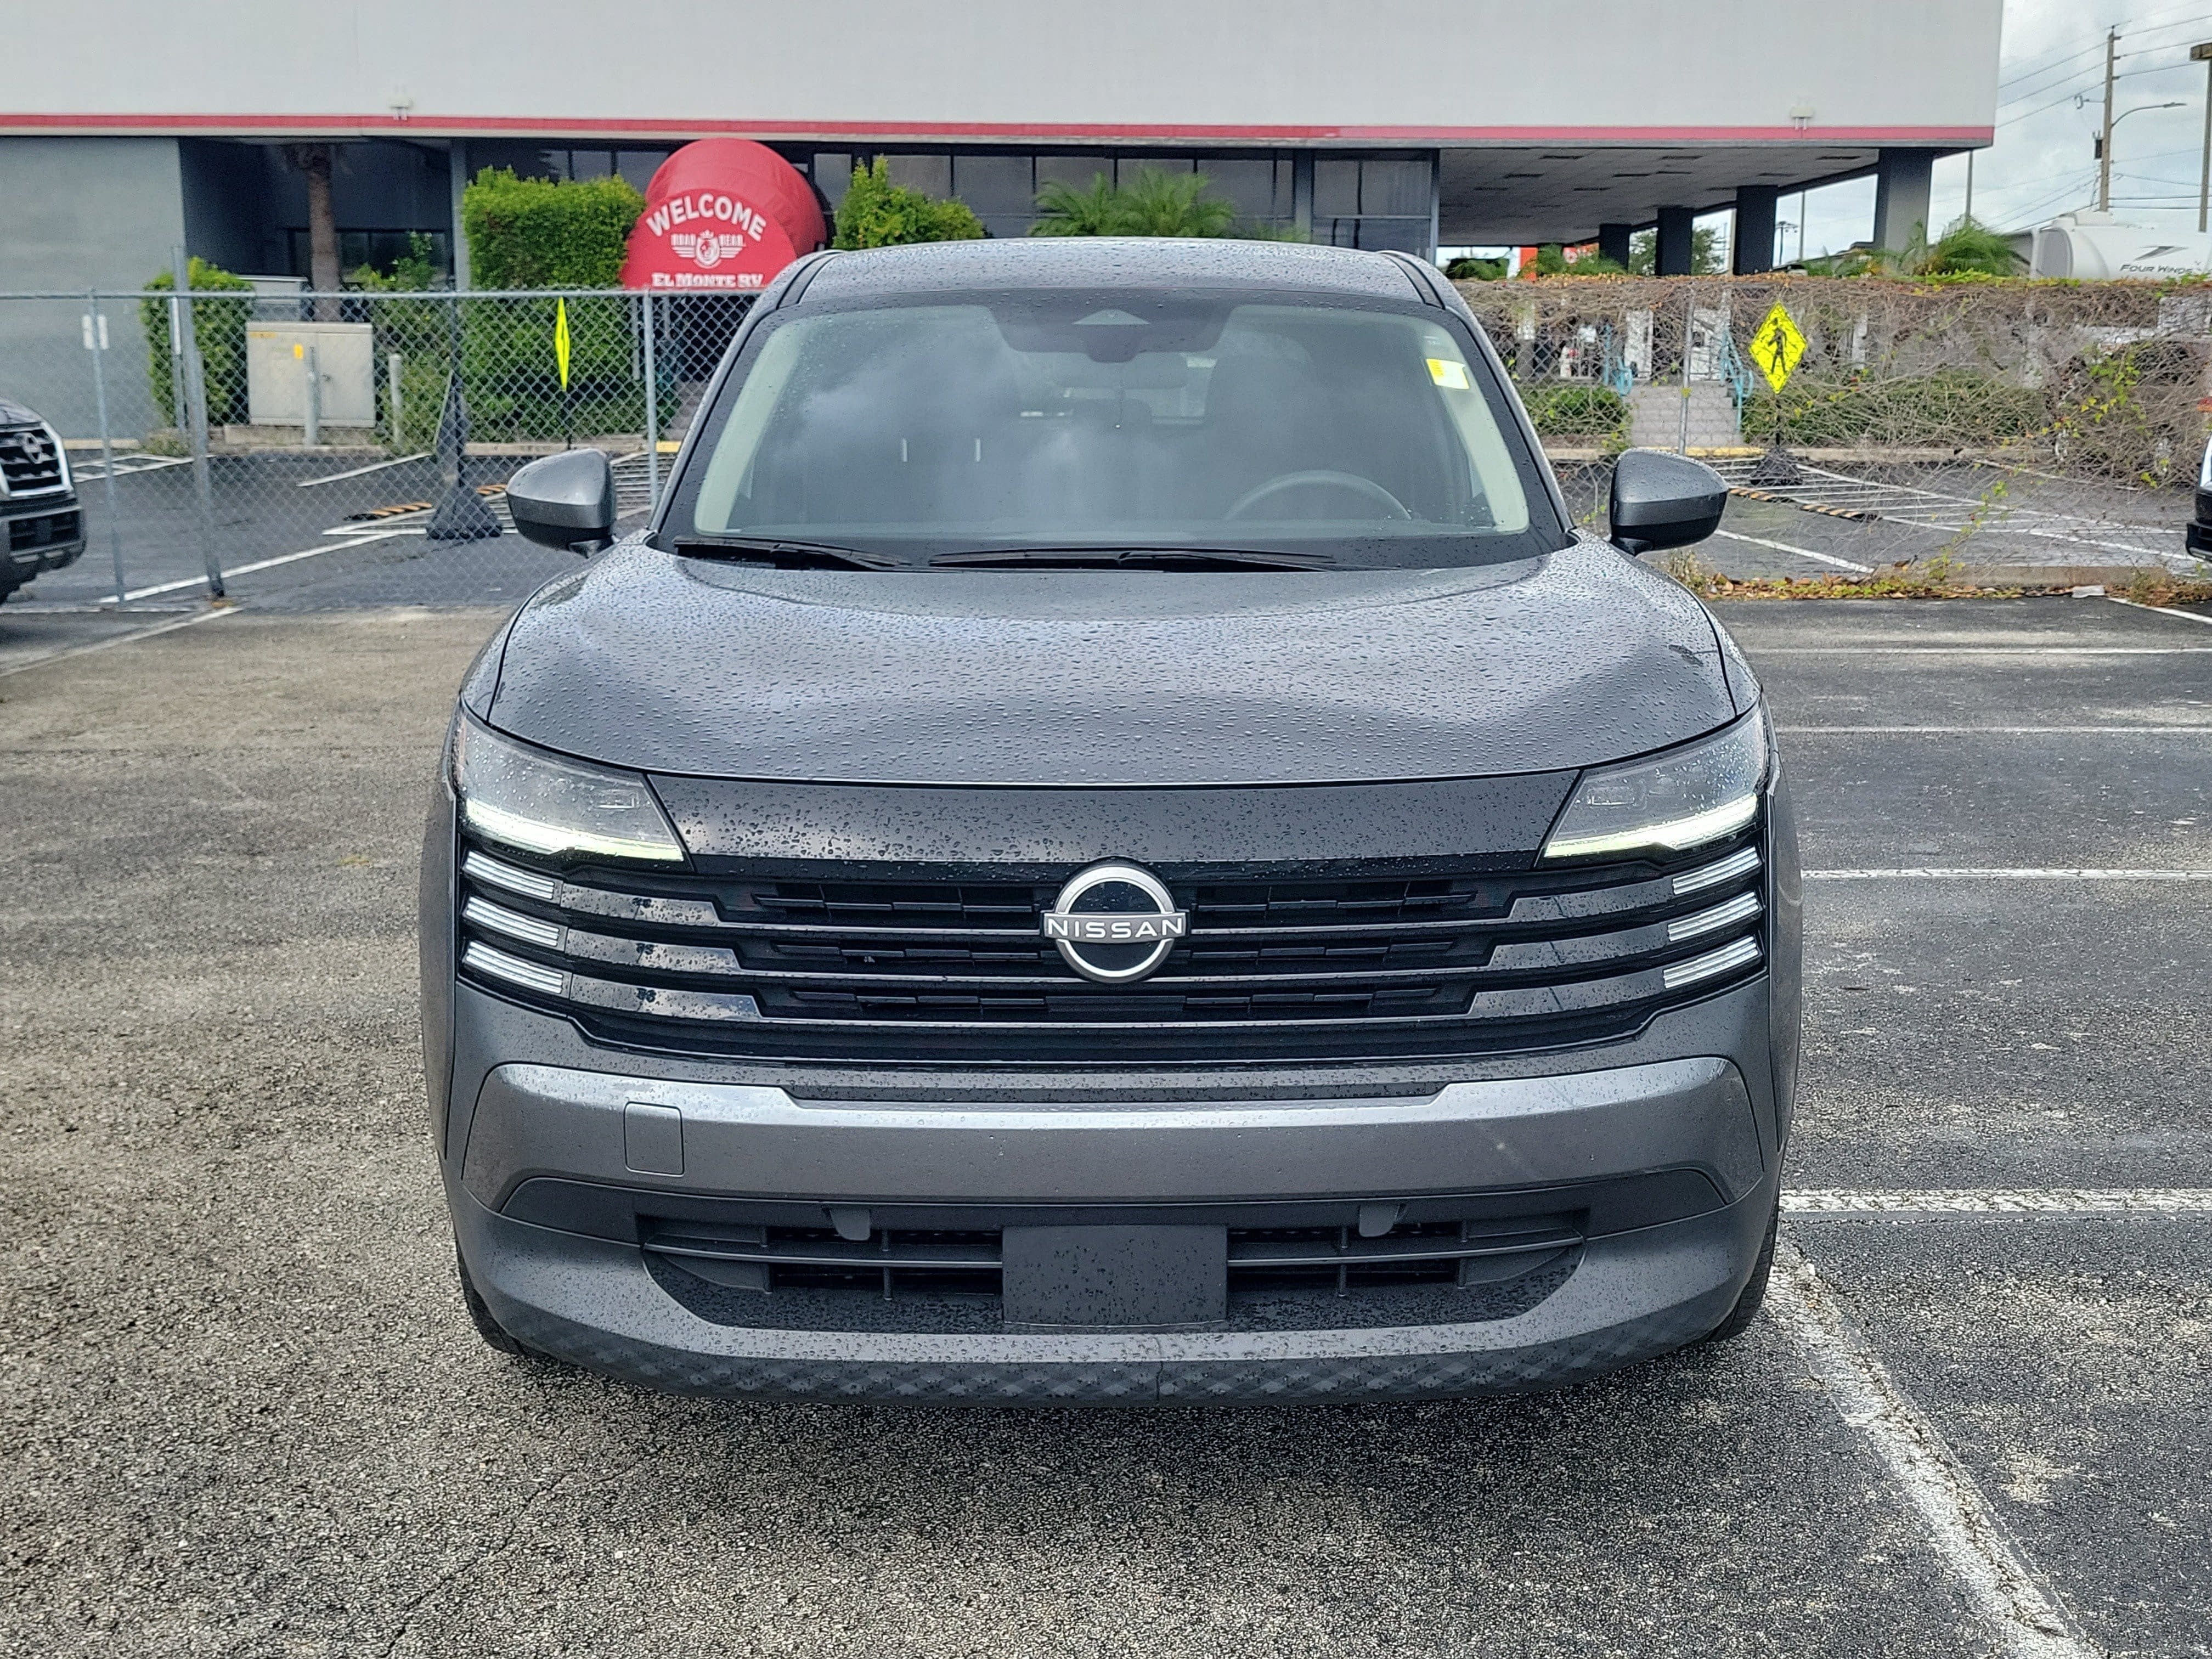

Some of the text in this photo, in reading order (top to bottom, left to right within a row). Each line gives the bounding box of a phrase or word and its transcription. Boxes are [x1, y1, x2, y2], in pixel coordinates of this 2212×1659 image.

[646, 193, 766, 241] WELCOME
[2119, 264, 2155, 272] FOUR
[652, 272, 764, 288] EL MONTE RV
[1048, 917, 1182, 939] NISSAN
